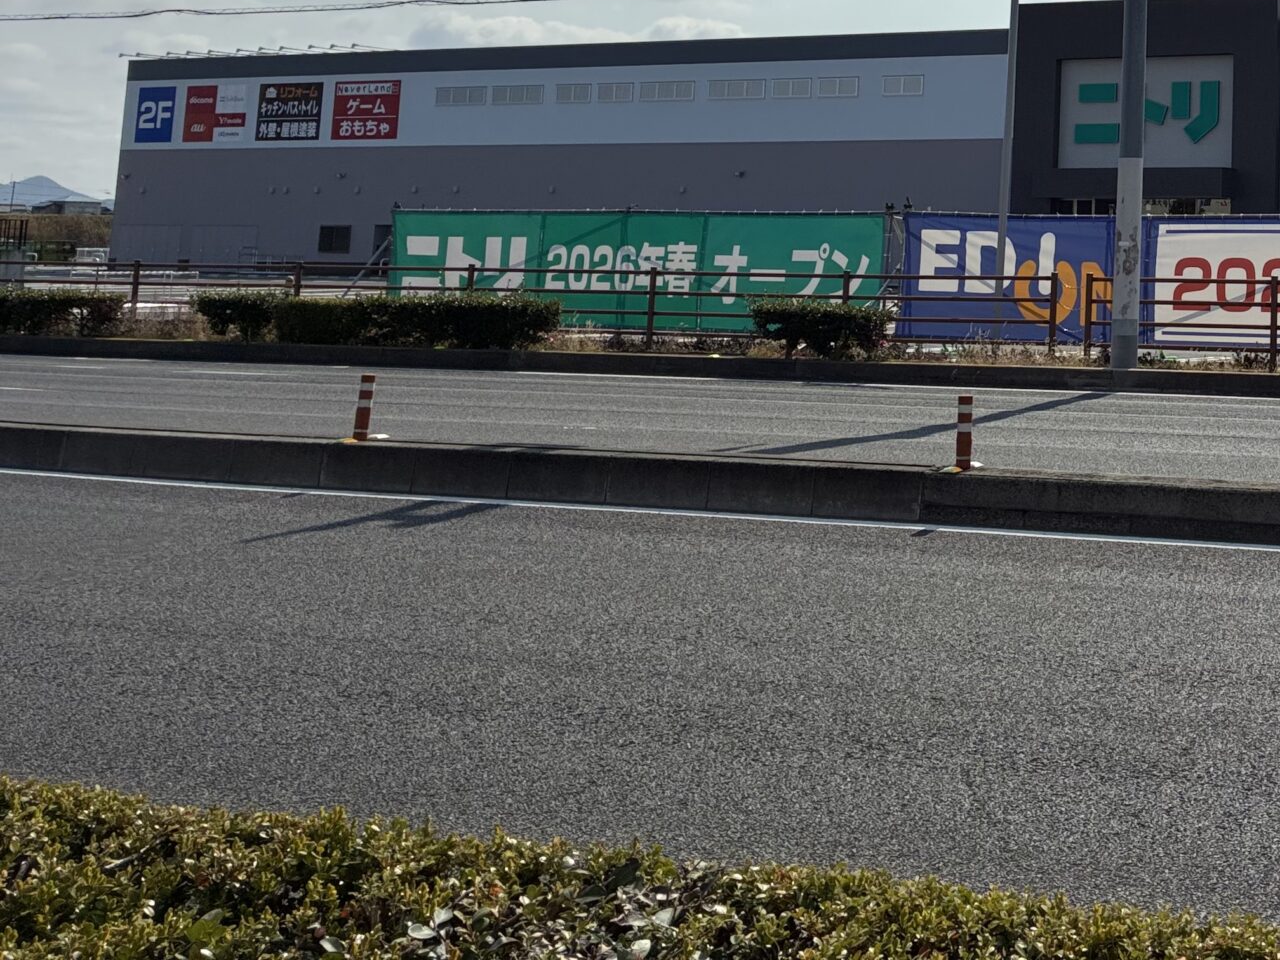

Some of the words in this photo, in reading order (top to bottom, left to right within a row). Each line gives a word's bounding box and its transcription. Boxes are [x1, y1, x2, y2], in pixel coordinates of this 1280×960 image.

[279, 87, 318, 98] リフォーム
[138, 101, 173, 129] 2F
[346, 98, 386, 115] ゲーム
[190, 123, 206, 133] au
[258, 121, 318, 138] 外壁・屋根塗装
[339, 120, 390, 136] おもちゃ
[401, 235, 528, 299] ニトリ
